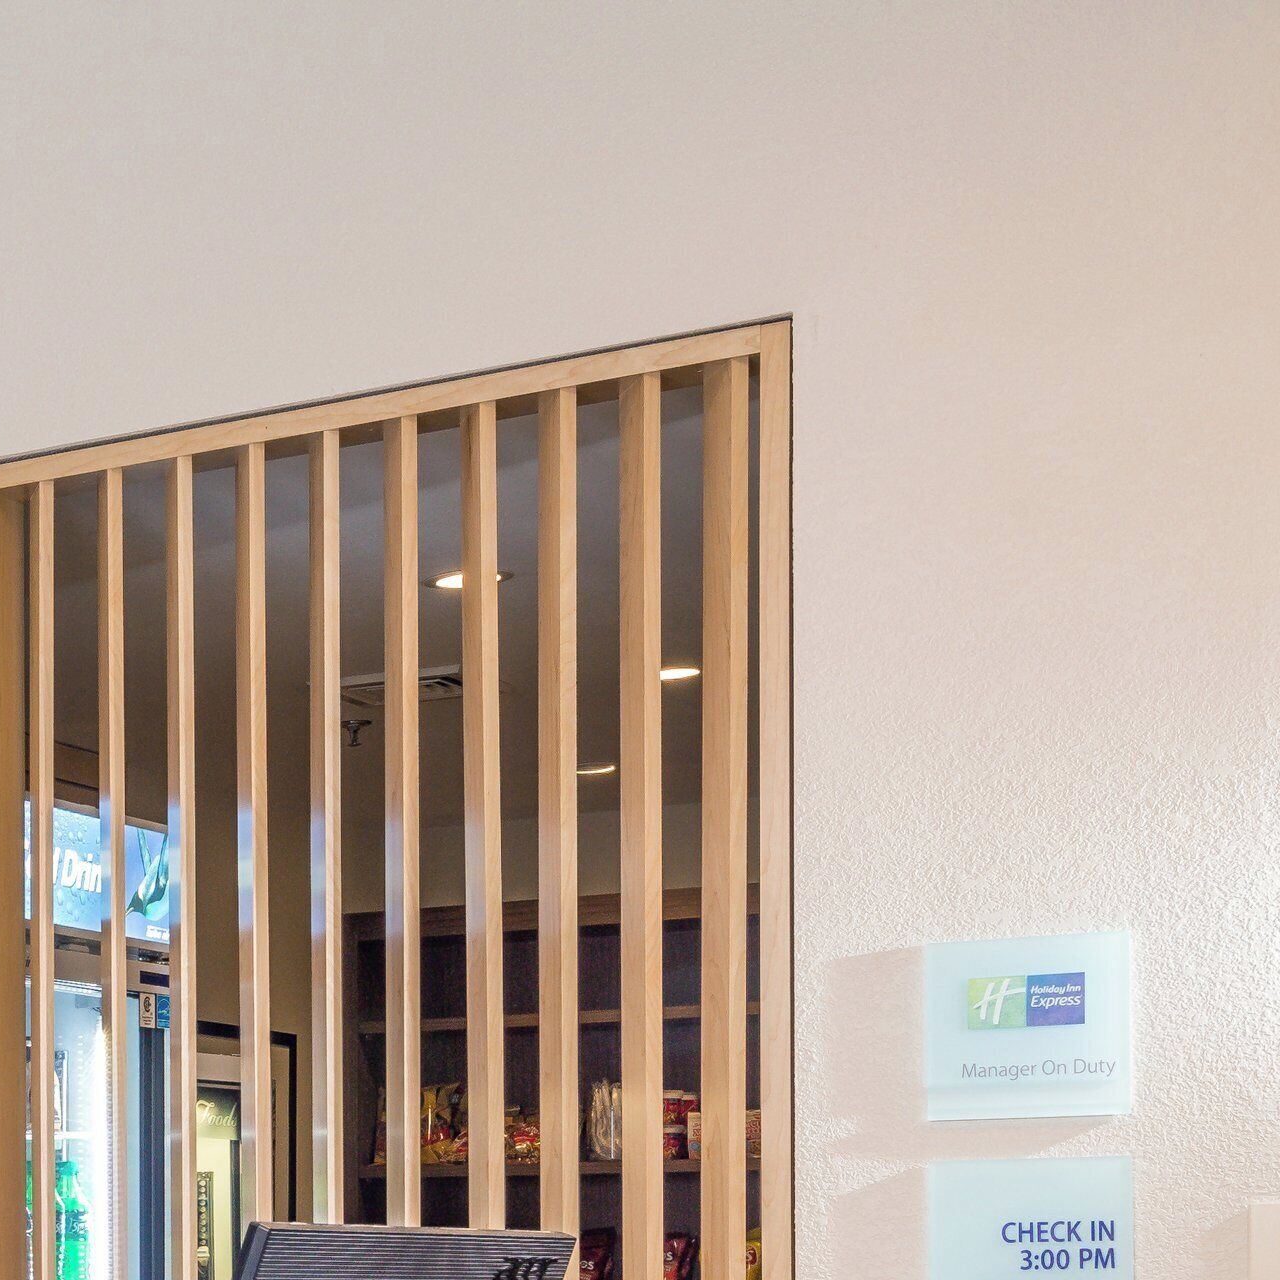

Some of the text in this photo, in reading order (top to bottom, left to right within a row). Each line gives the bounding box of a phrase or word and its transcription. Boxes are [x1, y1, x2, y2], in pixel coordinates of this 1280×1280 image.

[1030, 982, 1082, 995] Holiday Inn
[1030, 994, 1081, 1009] Express
[961, 1058, 1116, 1081] Manager On Duty
[1001, 1220, 1115, 1243] CHECK IN
[1020, 1248, 1116, 1271] 3:00 PM
